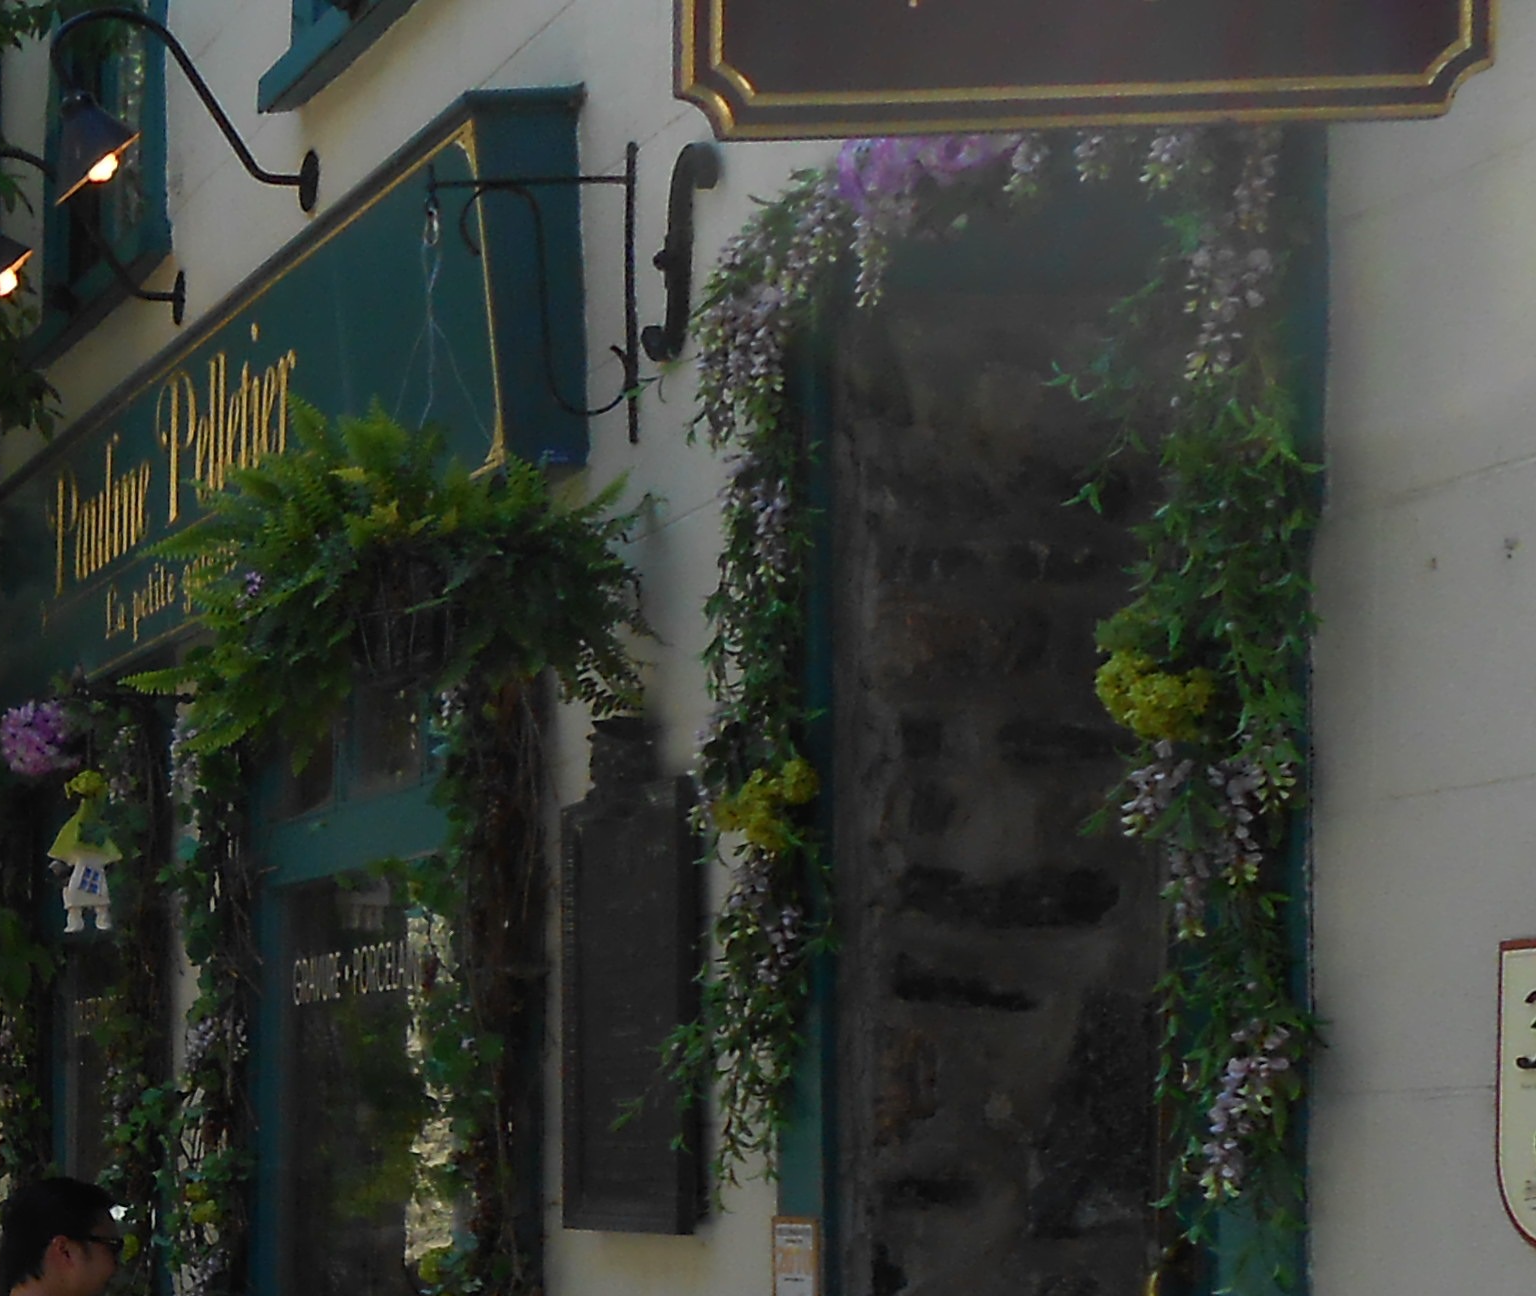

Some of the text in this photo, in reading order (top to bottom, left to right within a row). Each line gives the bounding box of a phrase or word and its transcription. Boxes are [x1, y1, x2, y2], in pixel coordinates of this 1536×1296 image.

[156, 322, 297, 528] Pelletier
[105, 583, 126, 640] La
[133, 562, 175, 642] petite
